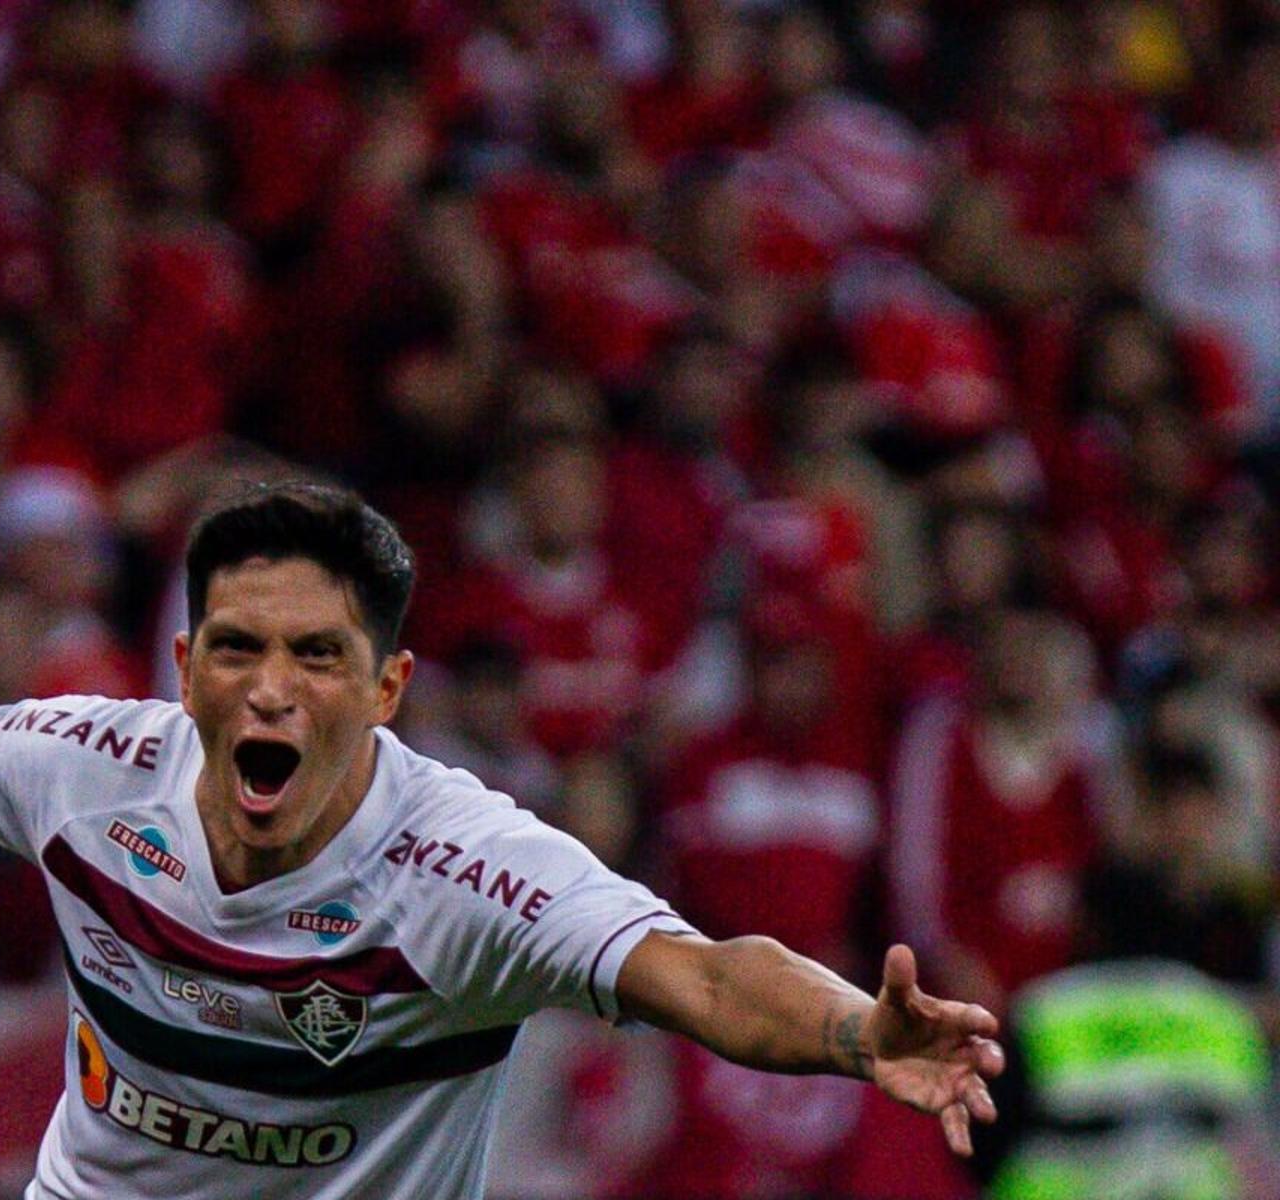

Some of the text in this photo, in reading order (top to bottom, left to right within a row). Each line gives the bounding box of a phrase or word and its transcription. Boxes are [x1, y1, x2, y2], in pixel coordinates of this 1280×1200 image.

[109, 824, 185, 879] FRESCATTO
[81, 955, 134, 995] umbro
[164, 969, 240, 1016] Leve
[107, 1076, 352, 1166] BETANO
